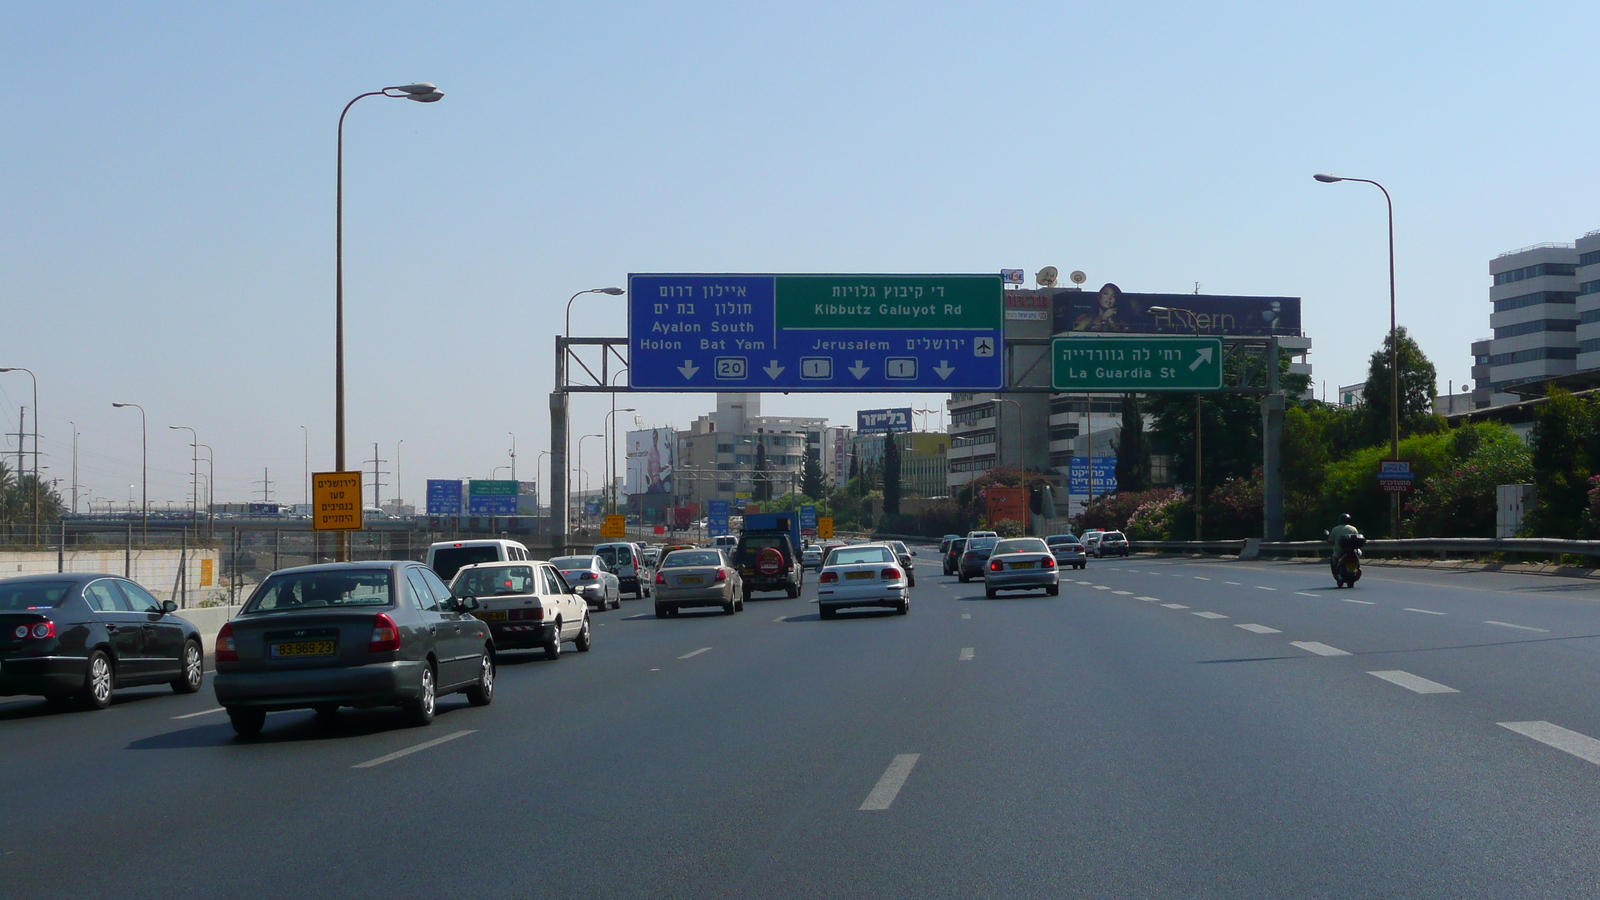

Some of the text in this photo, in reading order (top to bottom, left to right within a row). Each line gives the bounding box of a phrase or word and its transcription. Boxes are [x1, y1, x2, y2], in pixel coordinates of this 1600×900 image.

[659, 285, 747, 298] איילון דרום
[832, 285, 876, 297] גלויות
[883, 286, 923, 298] קיבוץ
[653, 302, 752, 315] חולון בת ים
[815, 303, 962, 318] Kibbutz Galuyot Rd
[652, 321, 754, 335] Ayalon South
[640, 338, 765, 350] Holon Bat Yam
[812, 338, 890, 350] Jerusalem
[905, 337, 965, 350] ירושלים
[1063, 349, 1124, 361] גוורדייה
[1132, 347, 1150, 361] לה
[721, 362, 741, 374] 20
[1069, 367, 1176, 379] La Guardia St
[861, 410, 907, 426] בלייזר
[318, 478, 357, 488] לירושלים
[330, 491, 345, 499] סעו
[321, 503, 354, 511] בנתיבים
